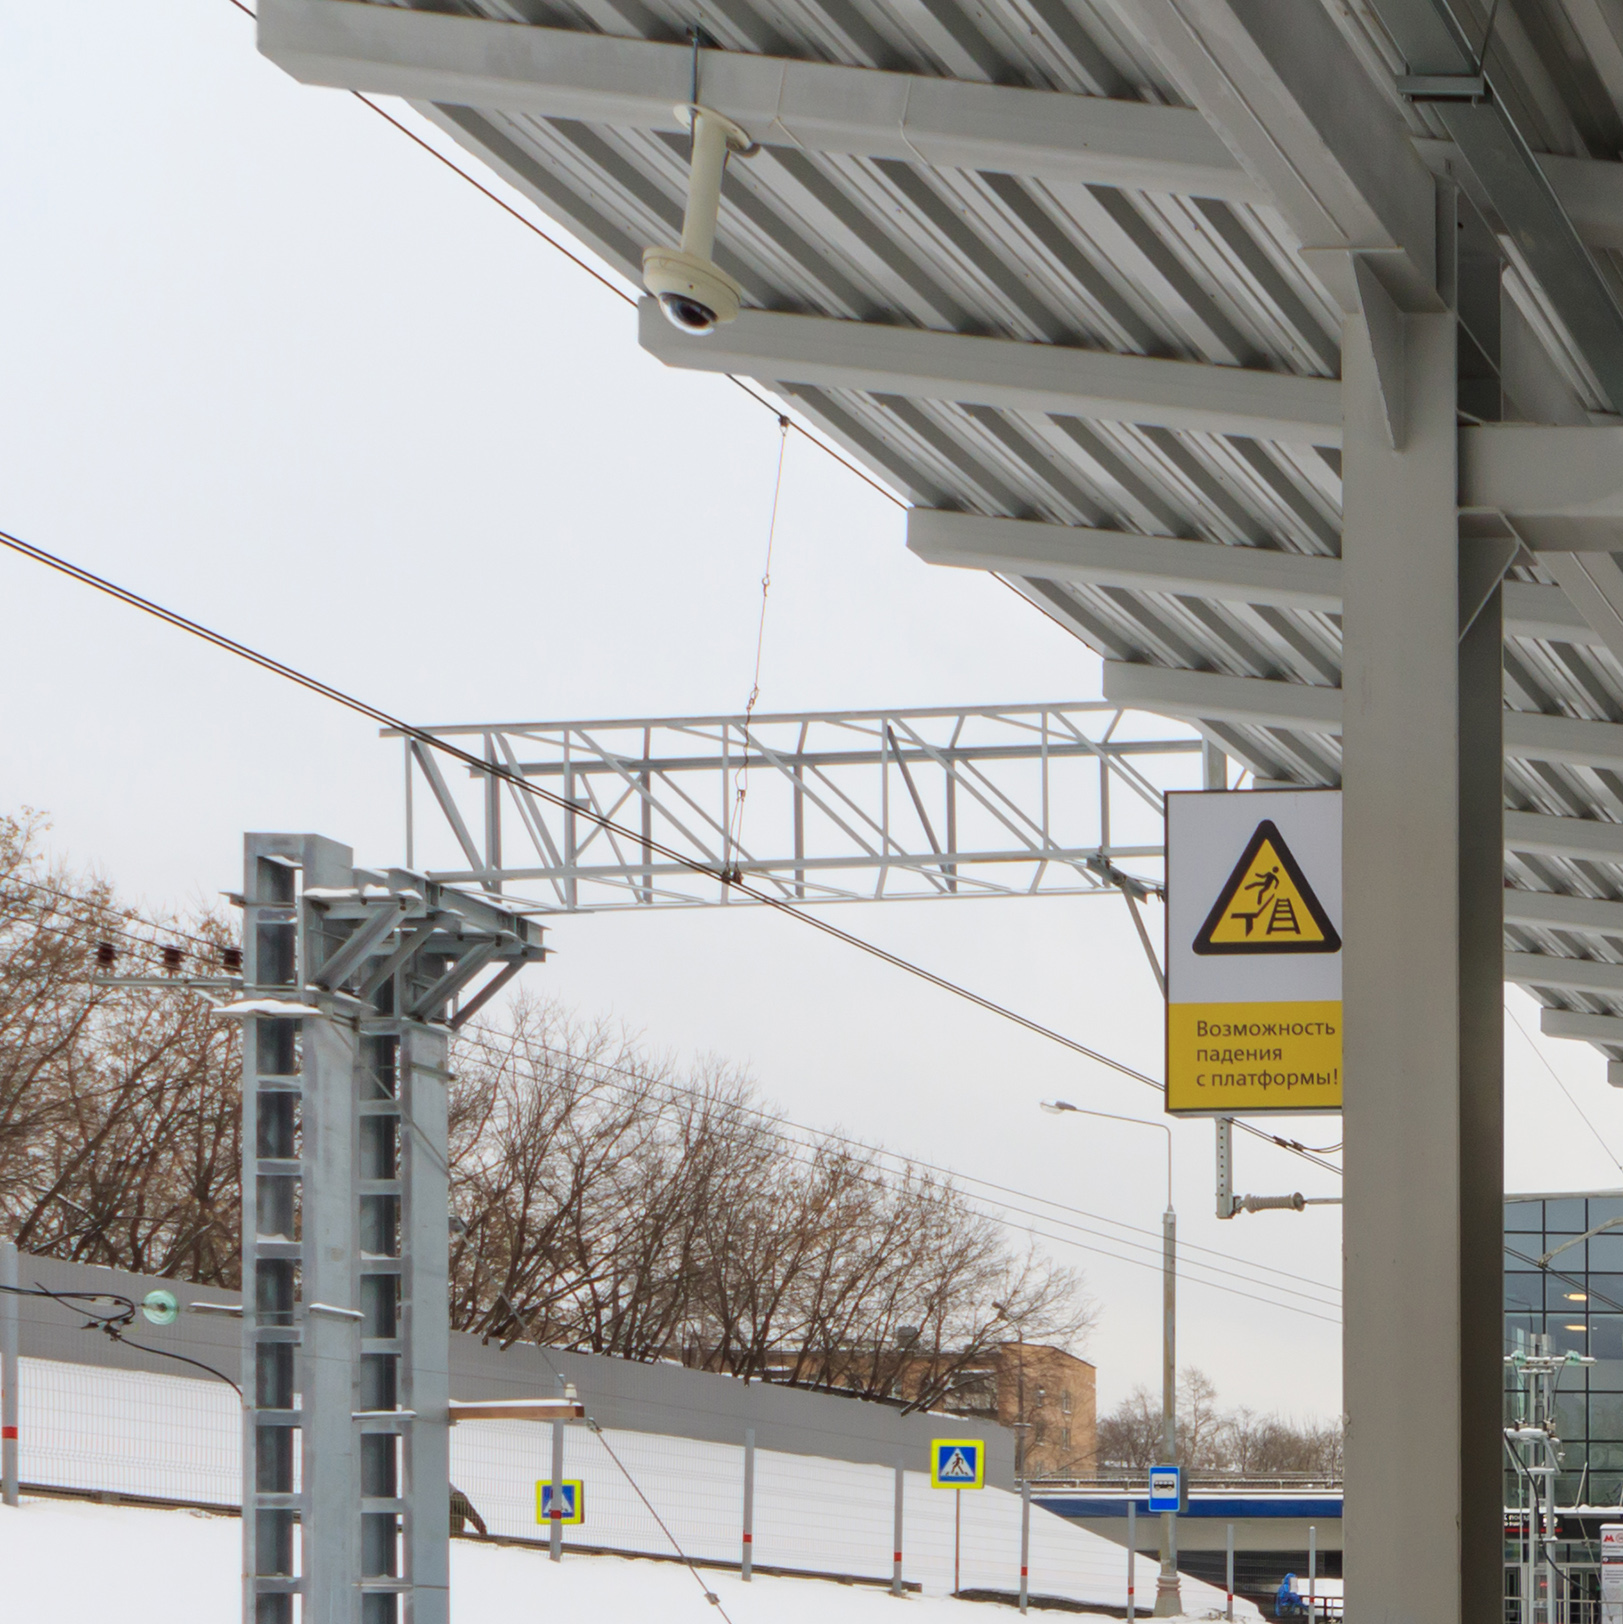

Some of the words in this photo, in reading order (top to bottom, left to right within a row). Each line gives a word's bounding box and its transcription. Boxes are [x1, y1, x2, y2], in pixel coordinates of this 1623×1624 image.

[1196, 1020, 1336, 1037] Возможность
[1196, 1047, 1283, 1064] падения
[1196, 1074, 1206, 1087] с
[1211, 1068, 1338, 1091] платформы!
